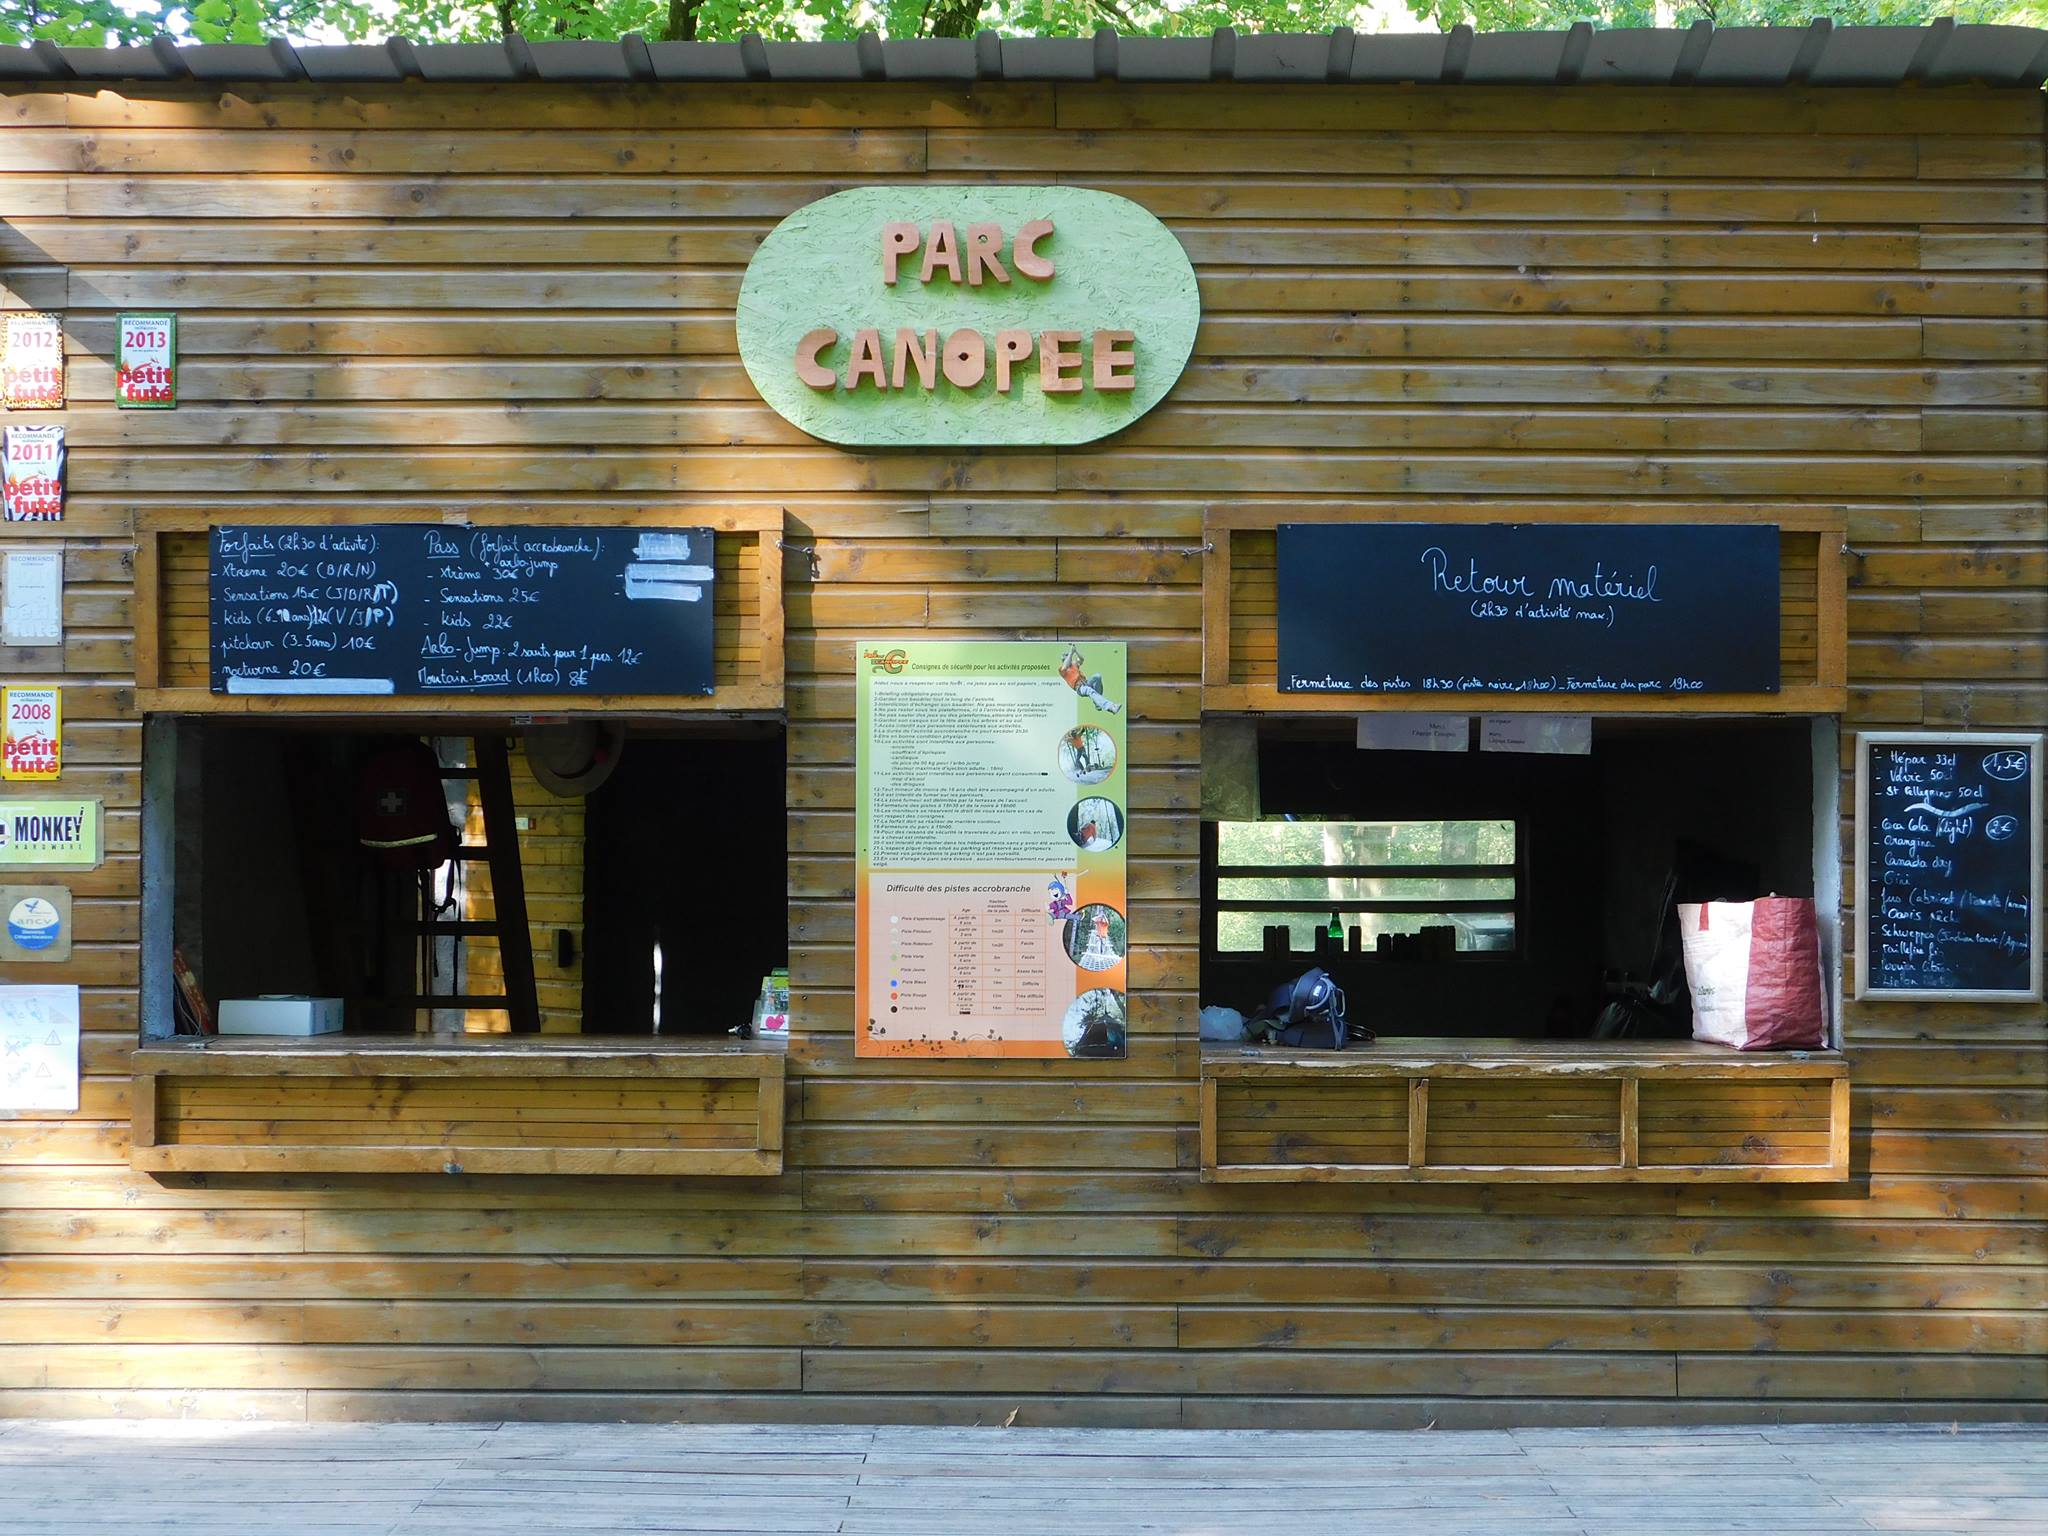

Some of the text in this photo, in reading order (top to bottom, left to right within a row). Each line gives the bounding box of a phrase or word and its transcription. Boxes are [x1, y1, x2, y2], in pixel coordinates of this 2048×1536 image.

[883, 219, 1056, 286] PARC
[12, 332, 54, 348] 2012
[124, 332, 166, 348] 2013
[794, 328, 1136, 393] CANOPEE
[4, 366, 60, 388] petit
[116, 366, 174, 388] petit
[14, 384, 60, 400] futé
[126, 384, 174, 401] futé
[12, 444, 53, 460] 2011
[4, 478, 61, 500] petit
[14, 496, 61, 514] futé
[218, 528, 275, 563] Forfaits
[424, 530, 459, 556] Pass
[277, 562, 308, 578] 20€
[492, 568, 518, 580] 30€
[1421, 546, 1662, 602] Retour matériel
[224, 586, 288, 602] Sensations
[292, 586, 319, 600] 15€
[440, 588, 540, 602] Sensations 25€
[482, 614, 513, 629] 22€
[1470, 600, 1614, 628] (2h30 d'activité max.)
[220, 634, 274, 658] pitchoun
[342, 637, 376, 650] 10€
[508, 641, 519, 657] 2
[521, 643, 550, 658] sauts
[554, 650, 576, 666] pour
[580, 645, 588, 660] 1
[618, 648, 643, 665] 12€
[222, 660, 326, 676] nocturne 20€
[517, 666, 560, 686] (1h00)
[569, 668, 588, 686] 8€
[912, 663, 940, 671] Consignes
[1291, 674, 1352, 689] Fermeture
[1360, 674, 1378, 688] des
[1383, 676, 1411, 691] pistes
[1422, 677, 1454, 689] 18h30
[1457, 676, 1484, 691] (piste
[1566, 676, 1618, 690] Fermeture
[1620, 679, 1637, 690] du
[1638, 680, 1662, 692] parc
[1669, 677, 1704, 690] 19h00
[12, 704, 51, 720] 2008
[2, 738, 59, 759] petit
[11, 756, 59, 773] futé
[1890, 751, 2025, 772] Hépar 33cl 1,5€
[1886, 786, 1900, 796] St
[1904, 786, 1951, 802] Pellegrino
[1882, 818, 1904, 830] Coca
[1908, 816, 1931, 831] Cola
[1990, 821, 2012, 834] 2€
[1884, 835, 1935, 858] Orangina
[1884, 852, 1952, 877] Canada dry
[886, 884, 1031, 894] Difficulté des pistes accrobranche
[1888, 908, 1922, 920] Oasis
